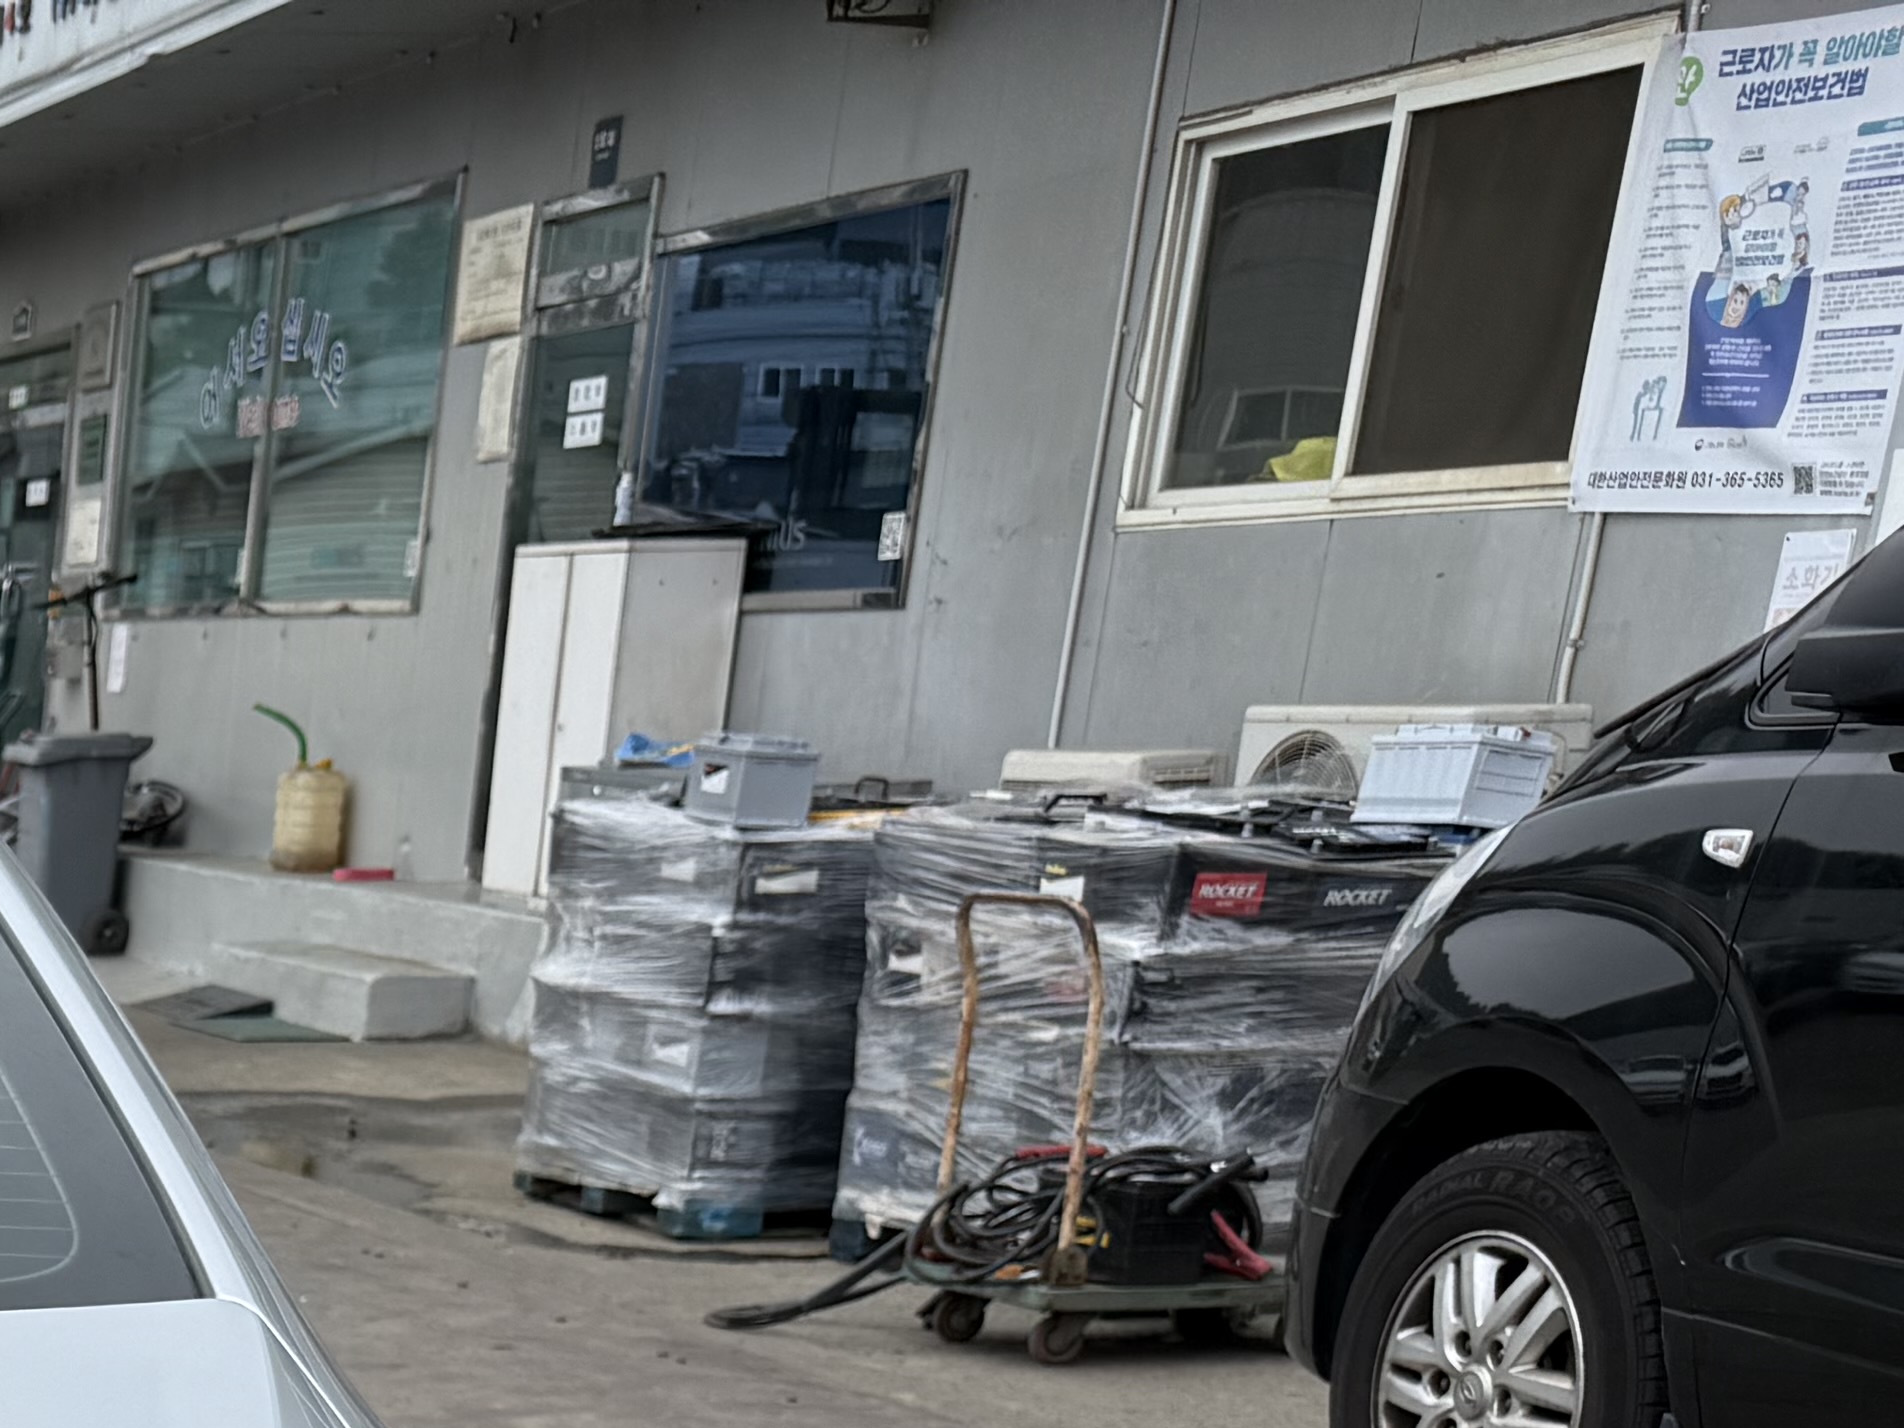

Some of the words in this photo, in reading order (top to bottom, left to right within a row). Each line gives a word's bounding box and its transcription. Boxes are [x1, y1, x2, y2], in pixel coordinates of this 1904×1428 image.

[1718, 42, 1794, 78] 근로자가
[1797, 38, 1820, 69] 꼭
[1735, 66, 1870, 112] 산업안전보건법
[1587, 471, 1687, 490] 대한산업안전문화원
[1691, 471, 1784, 488] 031-365-5365
[1199, 883, 1259, 899] ROCKET
[1324, 889, 1392, 907] ROCKET
